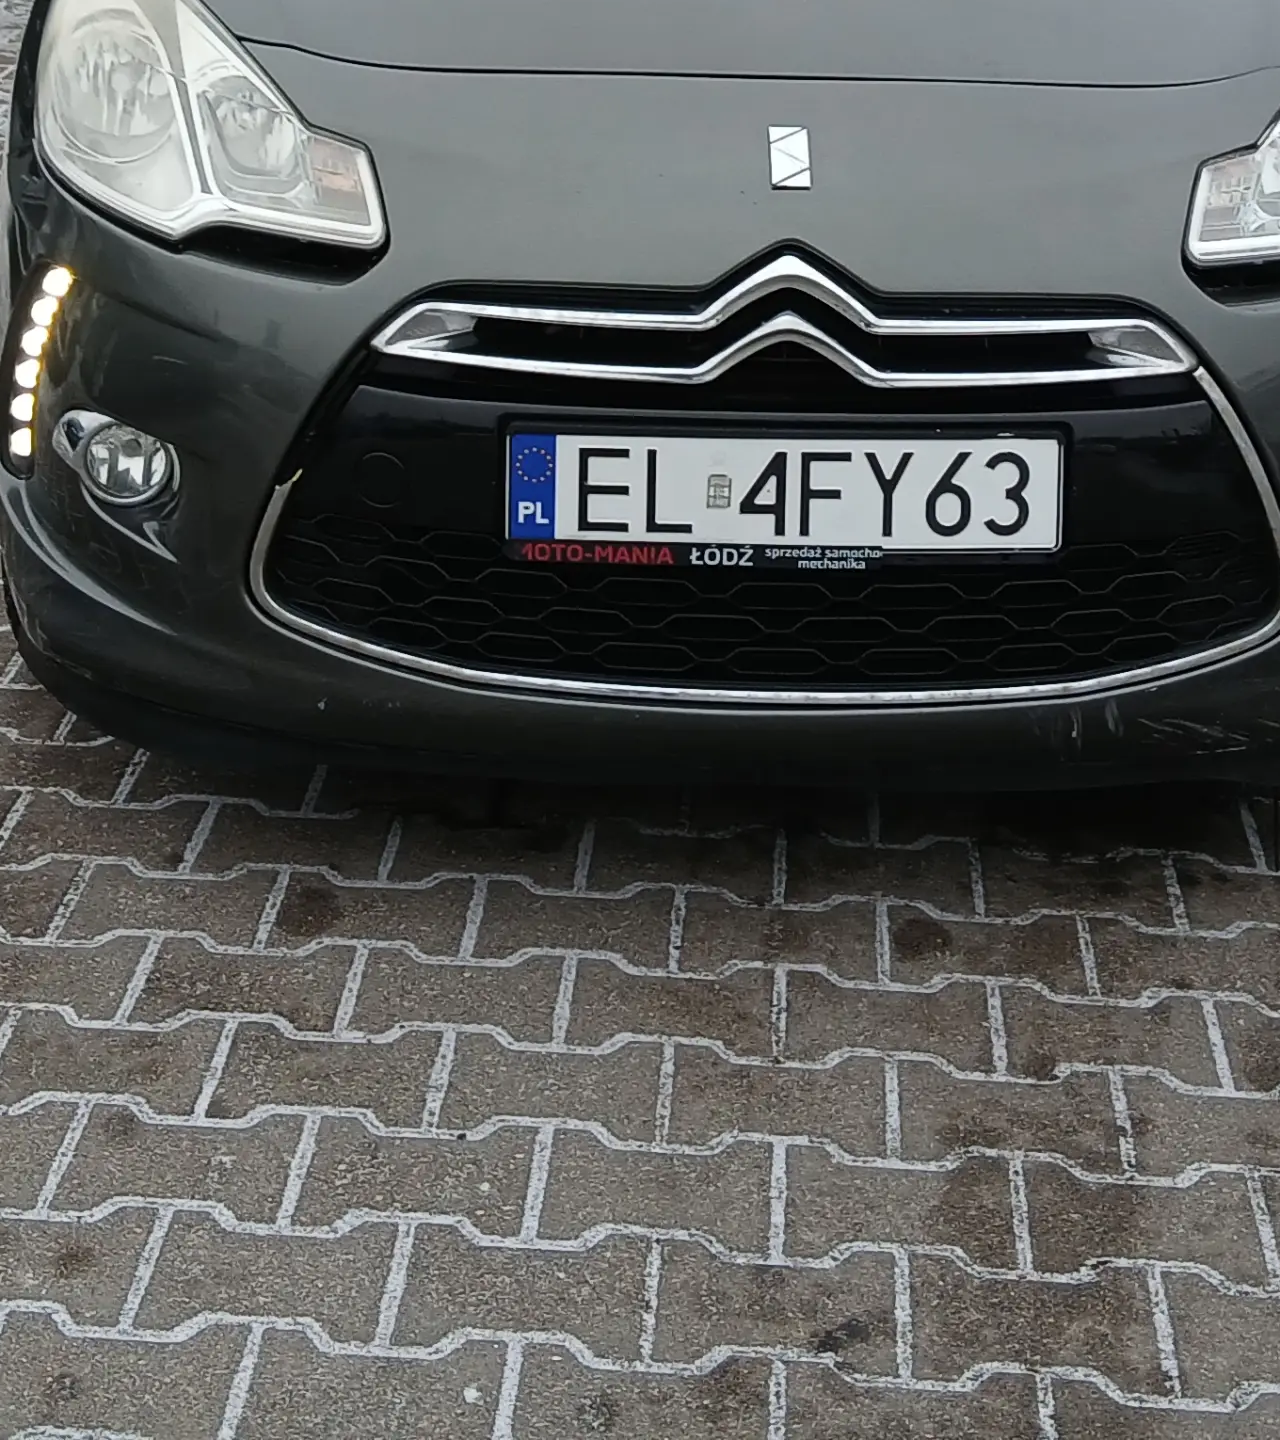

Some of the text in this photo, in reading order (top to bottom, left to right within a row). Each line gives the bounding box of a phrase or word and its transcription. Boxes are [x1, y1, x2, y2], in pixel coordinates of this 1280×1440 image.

[577, 447, 1031, 538] EL 4FY63
[517, 501, 550, 525] PL
[689, 545, 754, 567] ŁÓDŹ
[764, 547, 822, 559] sprzedaż
[797, 557, 866, 570] mechanika
